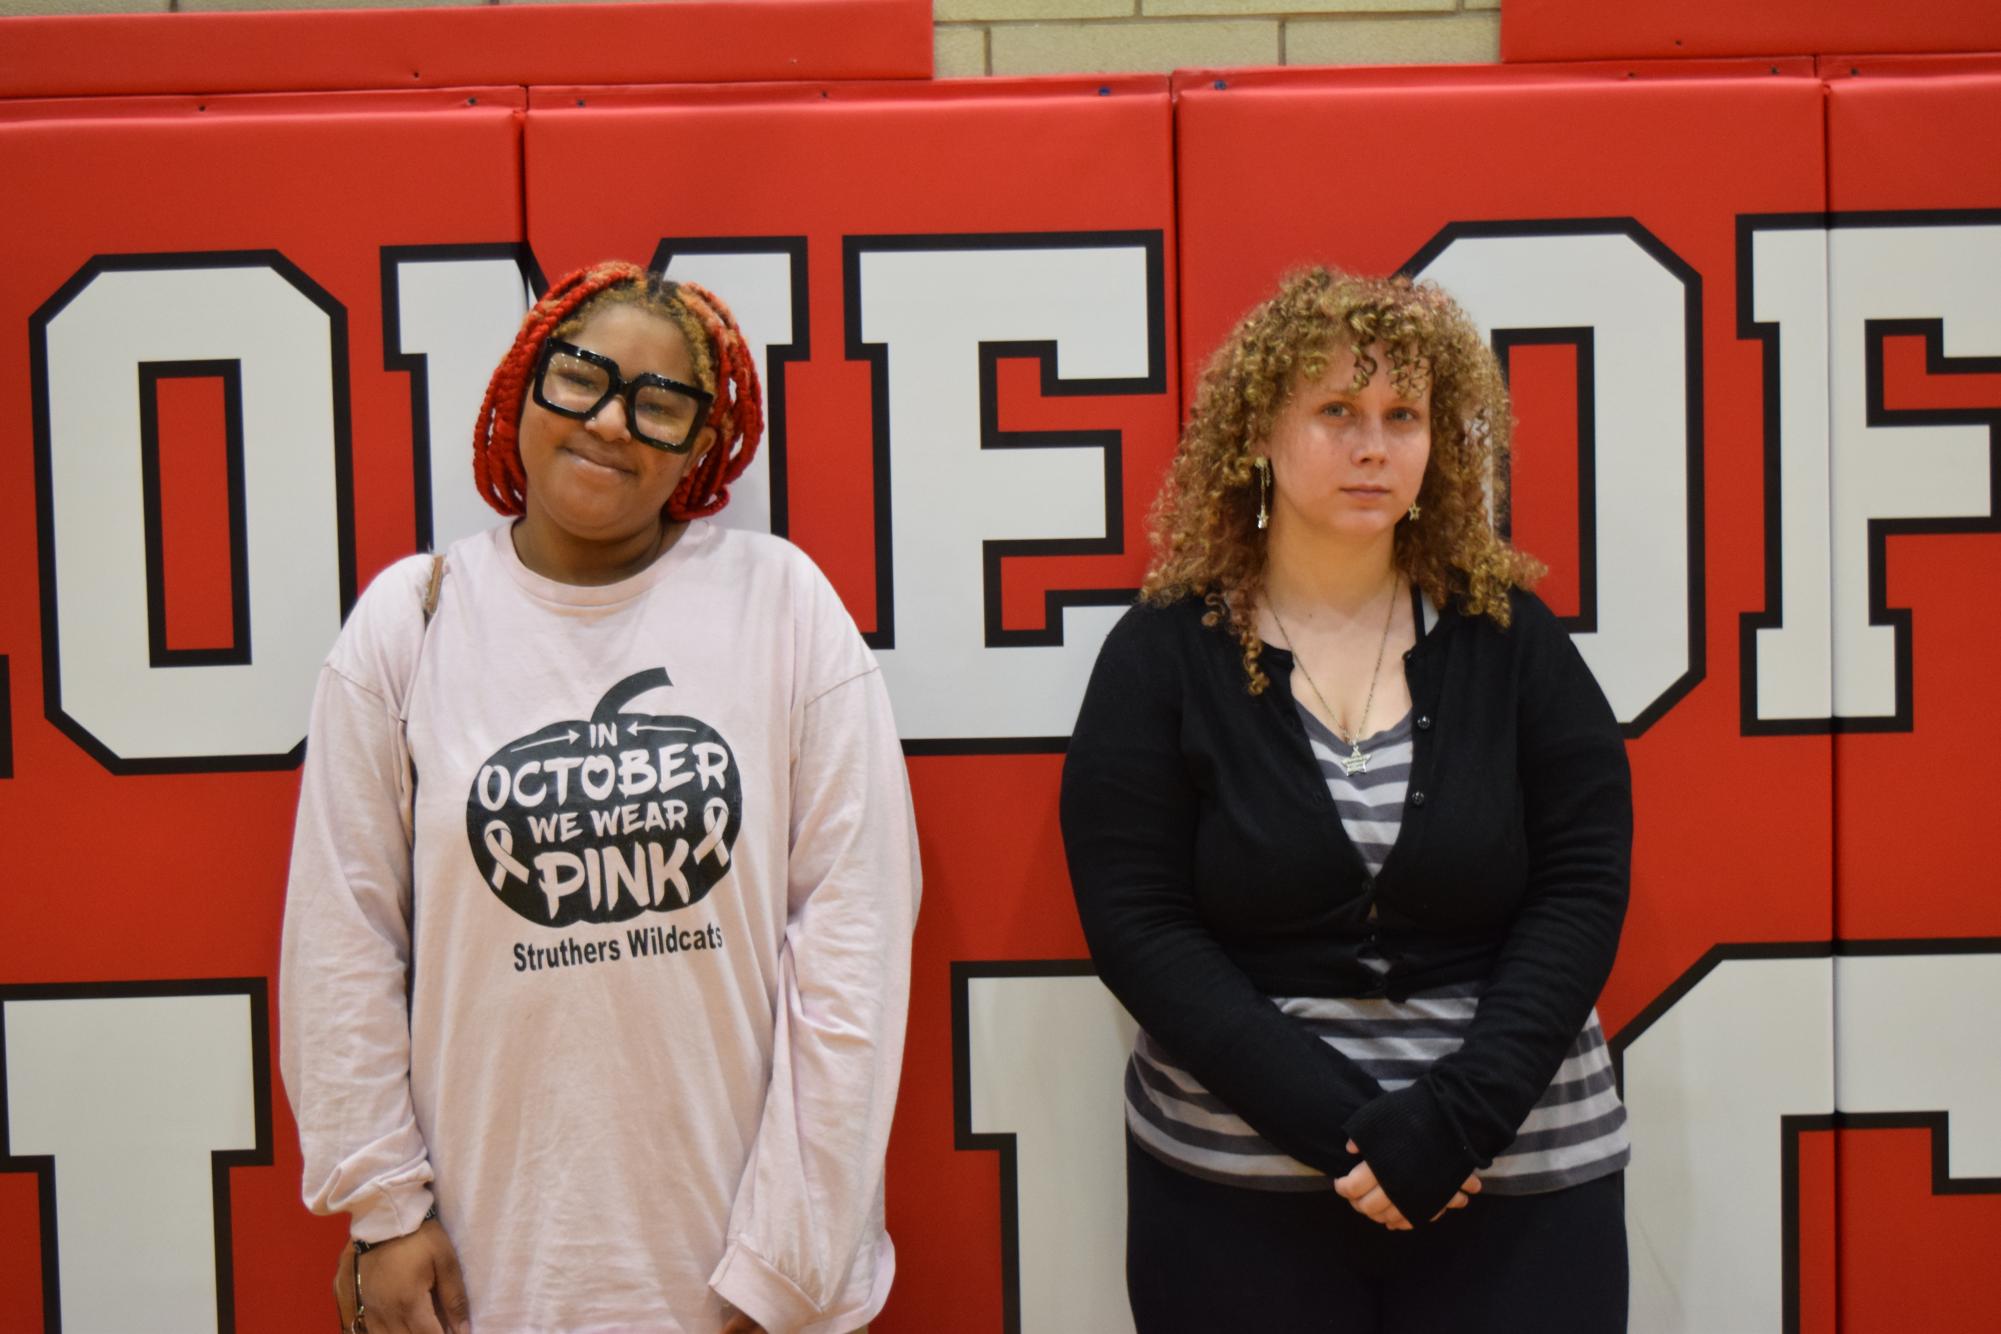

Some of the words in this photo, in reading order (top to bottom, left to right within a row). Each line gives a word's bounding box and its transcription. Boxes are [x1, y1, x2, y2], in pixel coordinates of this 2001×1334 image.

[589, 721, 619, 749] IN
[477, 742, 729, 812] OCTOBER
[527, 811, 583, 844] WE
[590, 799, 689, 837] WEAR
[533, 837, 690, 920] PINK
[512, 938, 621, 972] Struthers
[627, 922, 723, 958] Wildcats
